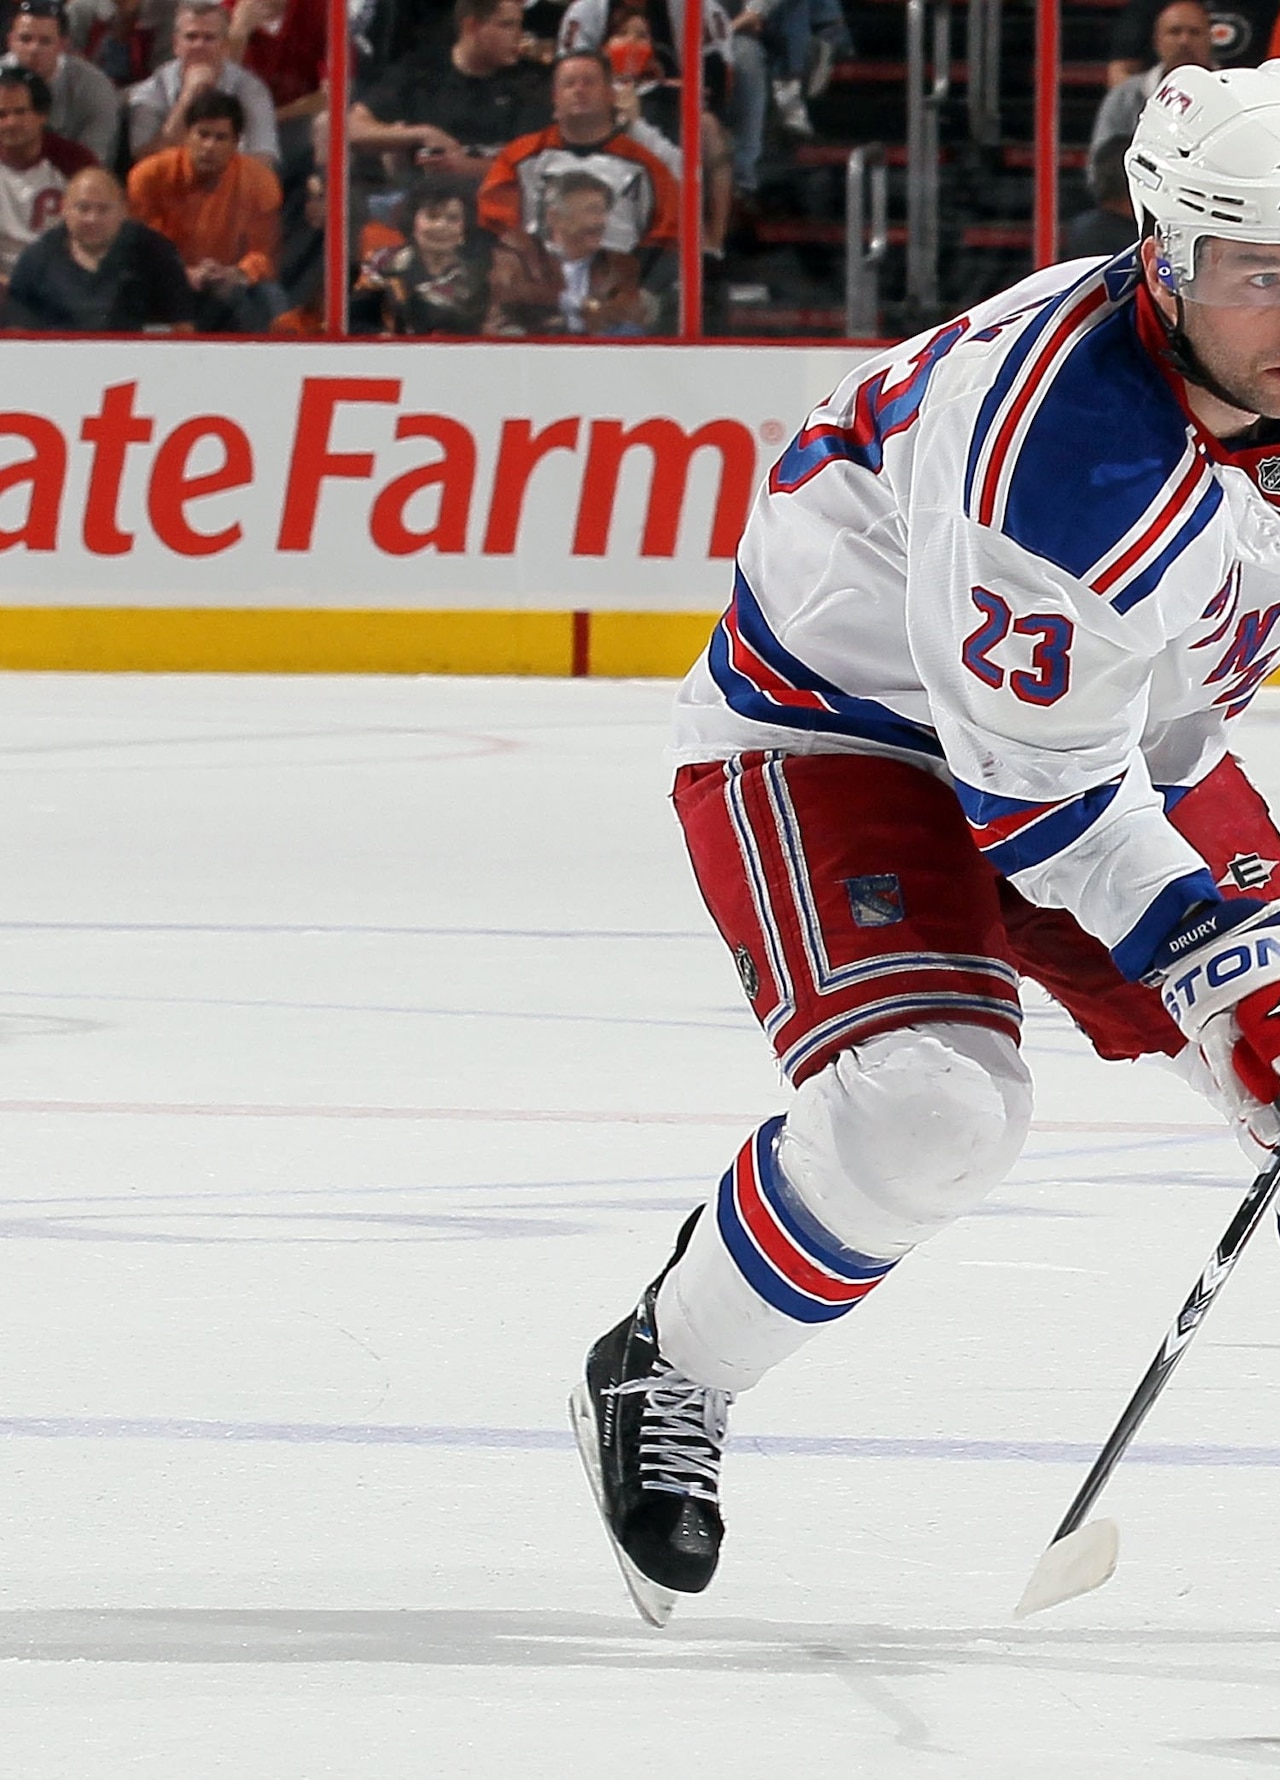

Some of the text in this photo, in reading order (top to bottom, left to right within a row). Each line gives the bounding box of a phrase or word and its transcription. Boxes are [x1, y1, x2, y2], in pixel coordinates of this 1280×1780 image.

[276, 375, 757, 560] Farm
[962, 585, 1075, 708] 23
[1168, 916, 1218, 954] DRURY
